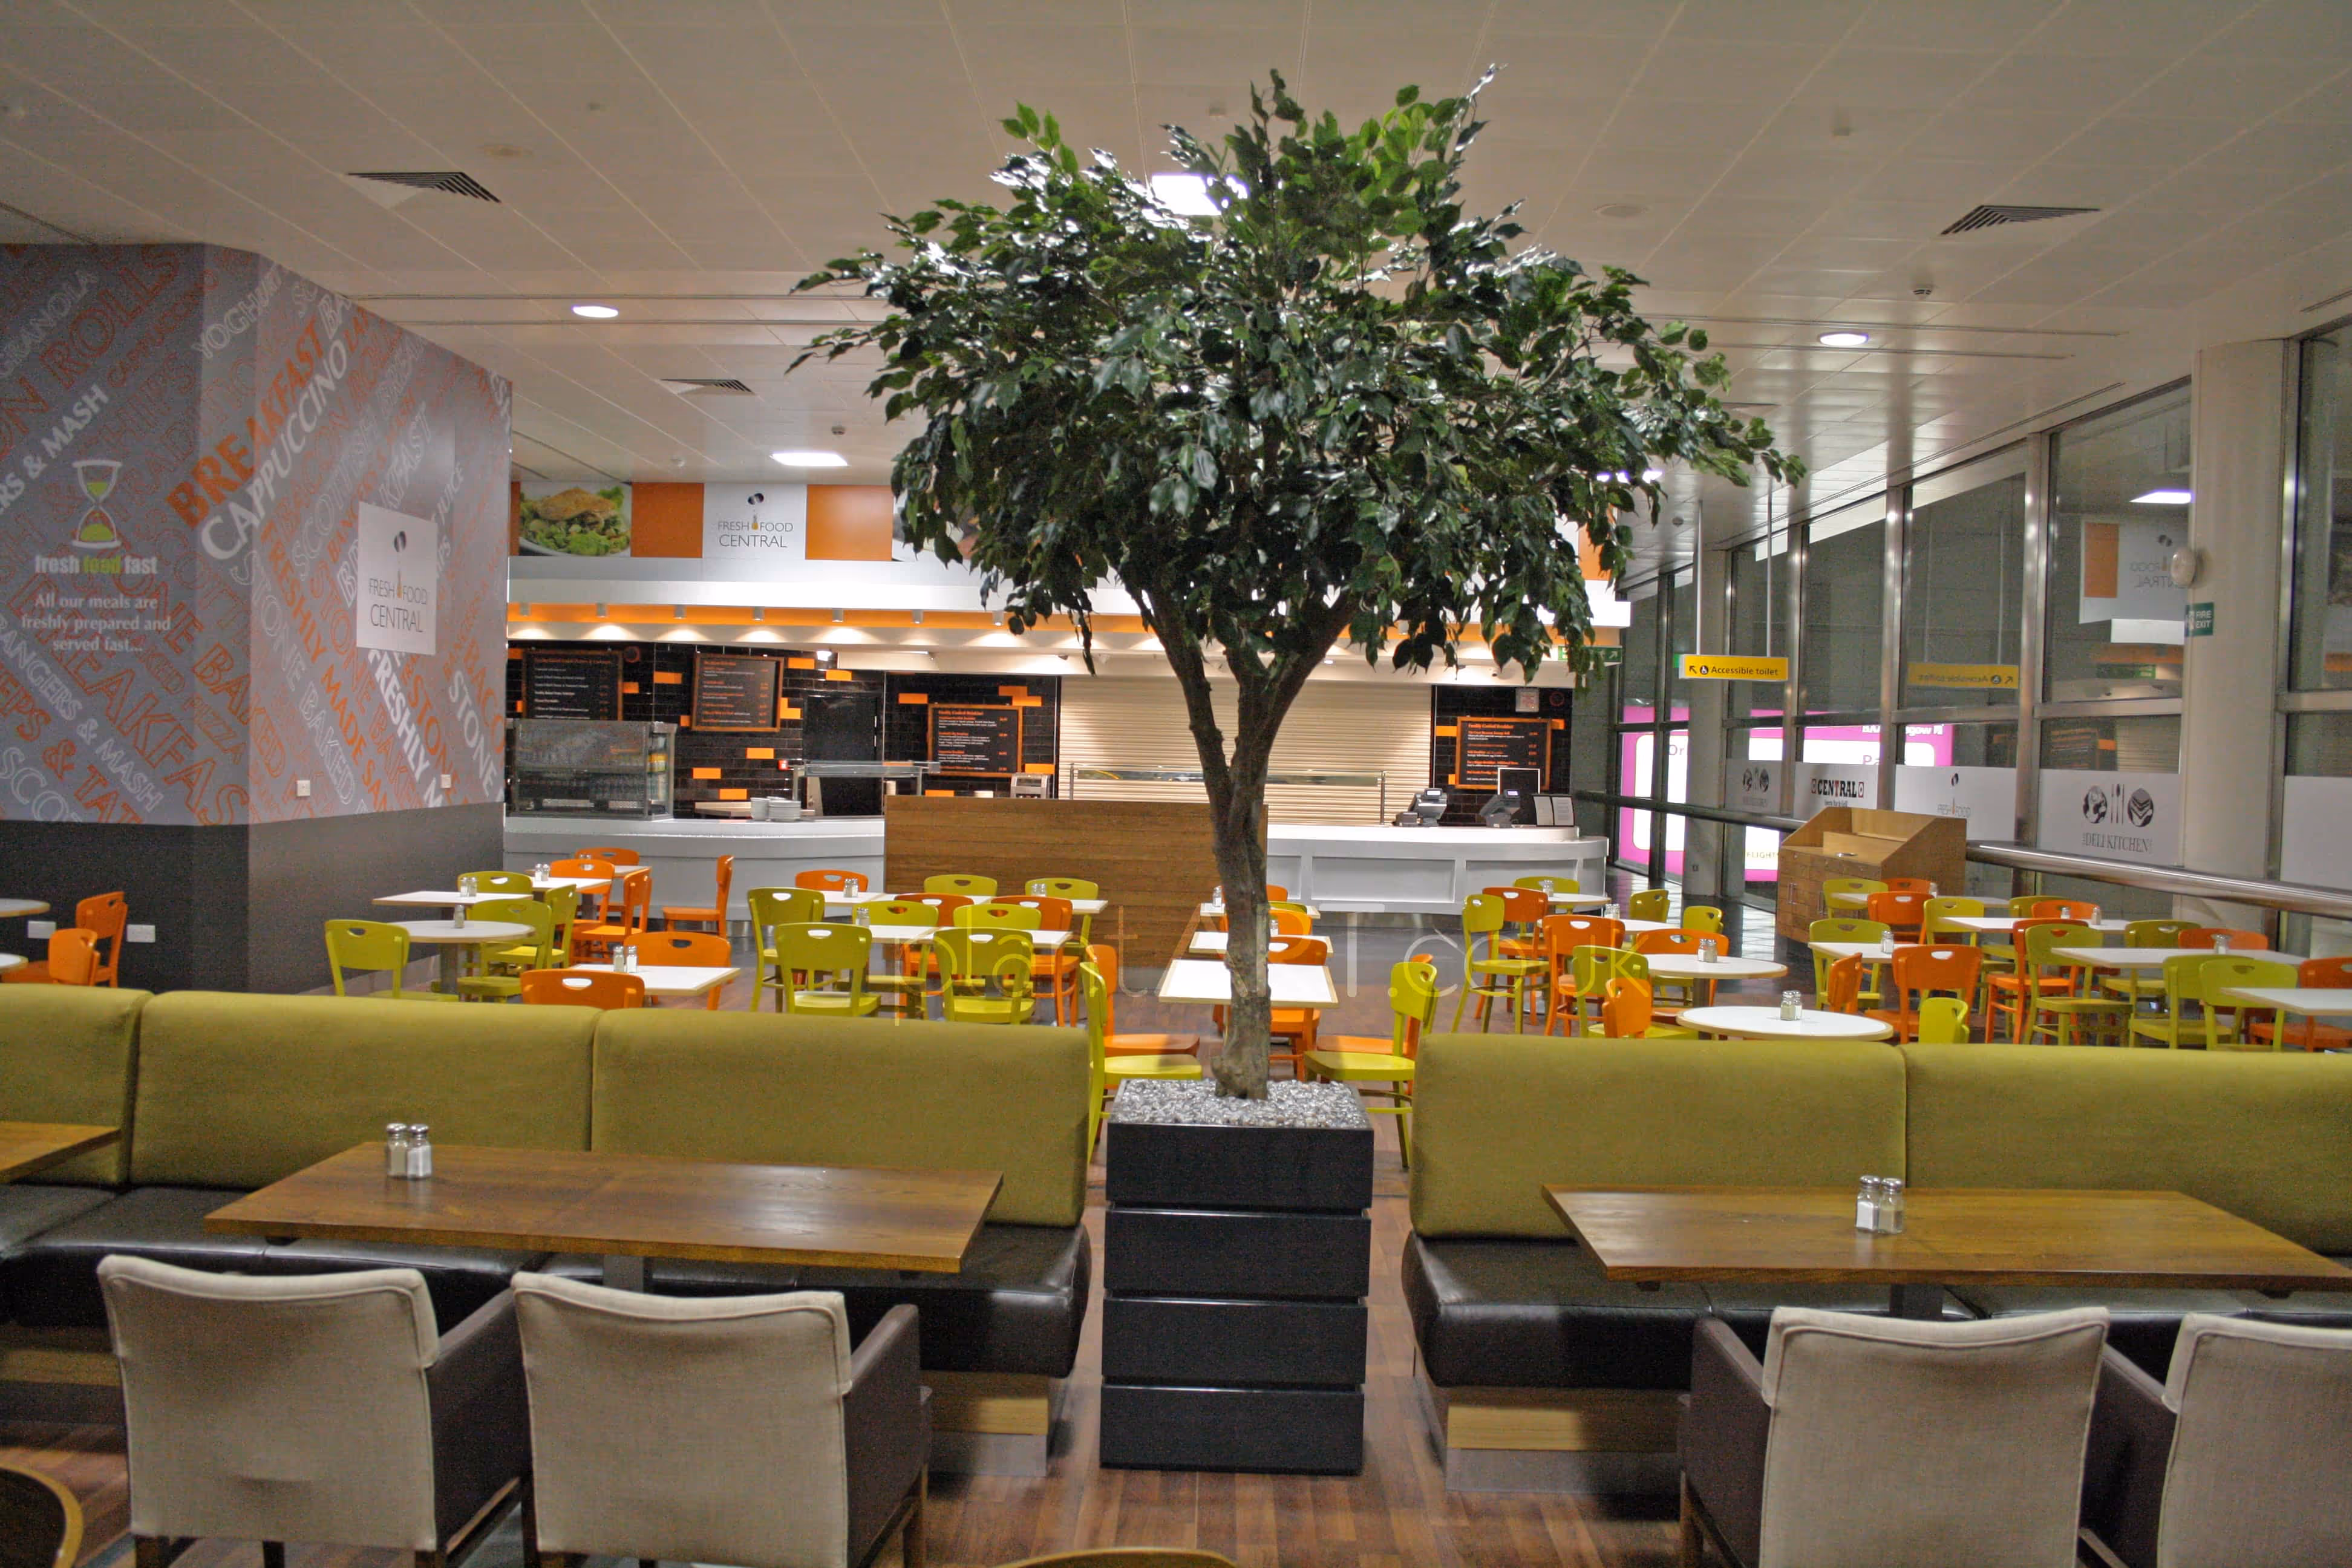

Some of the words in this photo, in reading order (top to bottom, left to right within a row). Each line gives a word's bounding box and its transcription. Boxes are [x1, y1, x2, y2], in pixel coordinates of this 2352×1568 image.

[39, 244, 180, 390] ROLLS
[41, 384, 110, 459] MASH
[165, 314, 323, 529] BREAKFAST
[201, 339, 347, 560] CAPPUCCINO
[717, 521, 750, 531] FRESH
[759, 522, 794, 532] FOOD
[719, 534, 788, 548] CENTRAL
[34, 555, 80, 573] fresh
[83, 555, 121, 573] food
[125, 555, 158, 573] fast
[34, 593, 55, 608] All
[59, 596, 85, 609] our
[88, 593, 131, 609] meals
[134, 596, 158, 609] are
[368, 577, 395, 600] FRESH
[402, 585, 427, 605] FOOD
[21, 615, 70, 633] freshly
[74, 615, 140, 633] prepared
[143, 615, 172, 630] and
[370, 603, 423, 633] CENTRAL
[2196, 610, 2212, 619] FIRE
[2196, 620, 2212, 629] EXIT
[53, 636, 100, 651] served
[260, 519, 327, 664] FRESHLY
[320, 664, 367, 766] MADE
[1711, 666, 1754, 675] Accessible
[1756, 667, 1779, 676] toilet
[7, 572, 251, 825] BREAKFAS
[299, 680, 356, 805] BAKED
[448, 670, 498, 797] STONE
[95, 738, 165, 813] MASH
[1817, 779, 1857, 799] CENTRAL
[2085, 832, 2105, 848] DELI
[2106, 834, 2149, 853] KITCHEN
